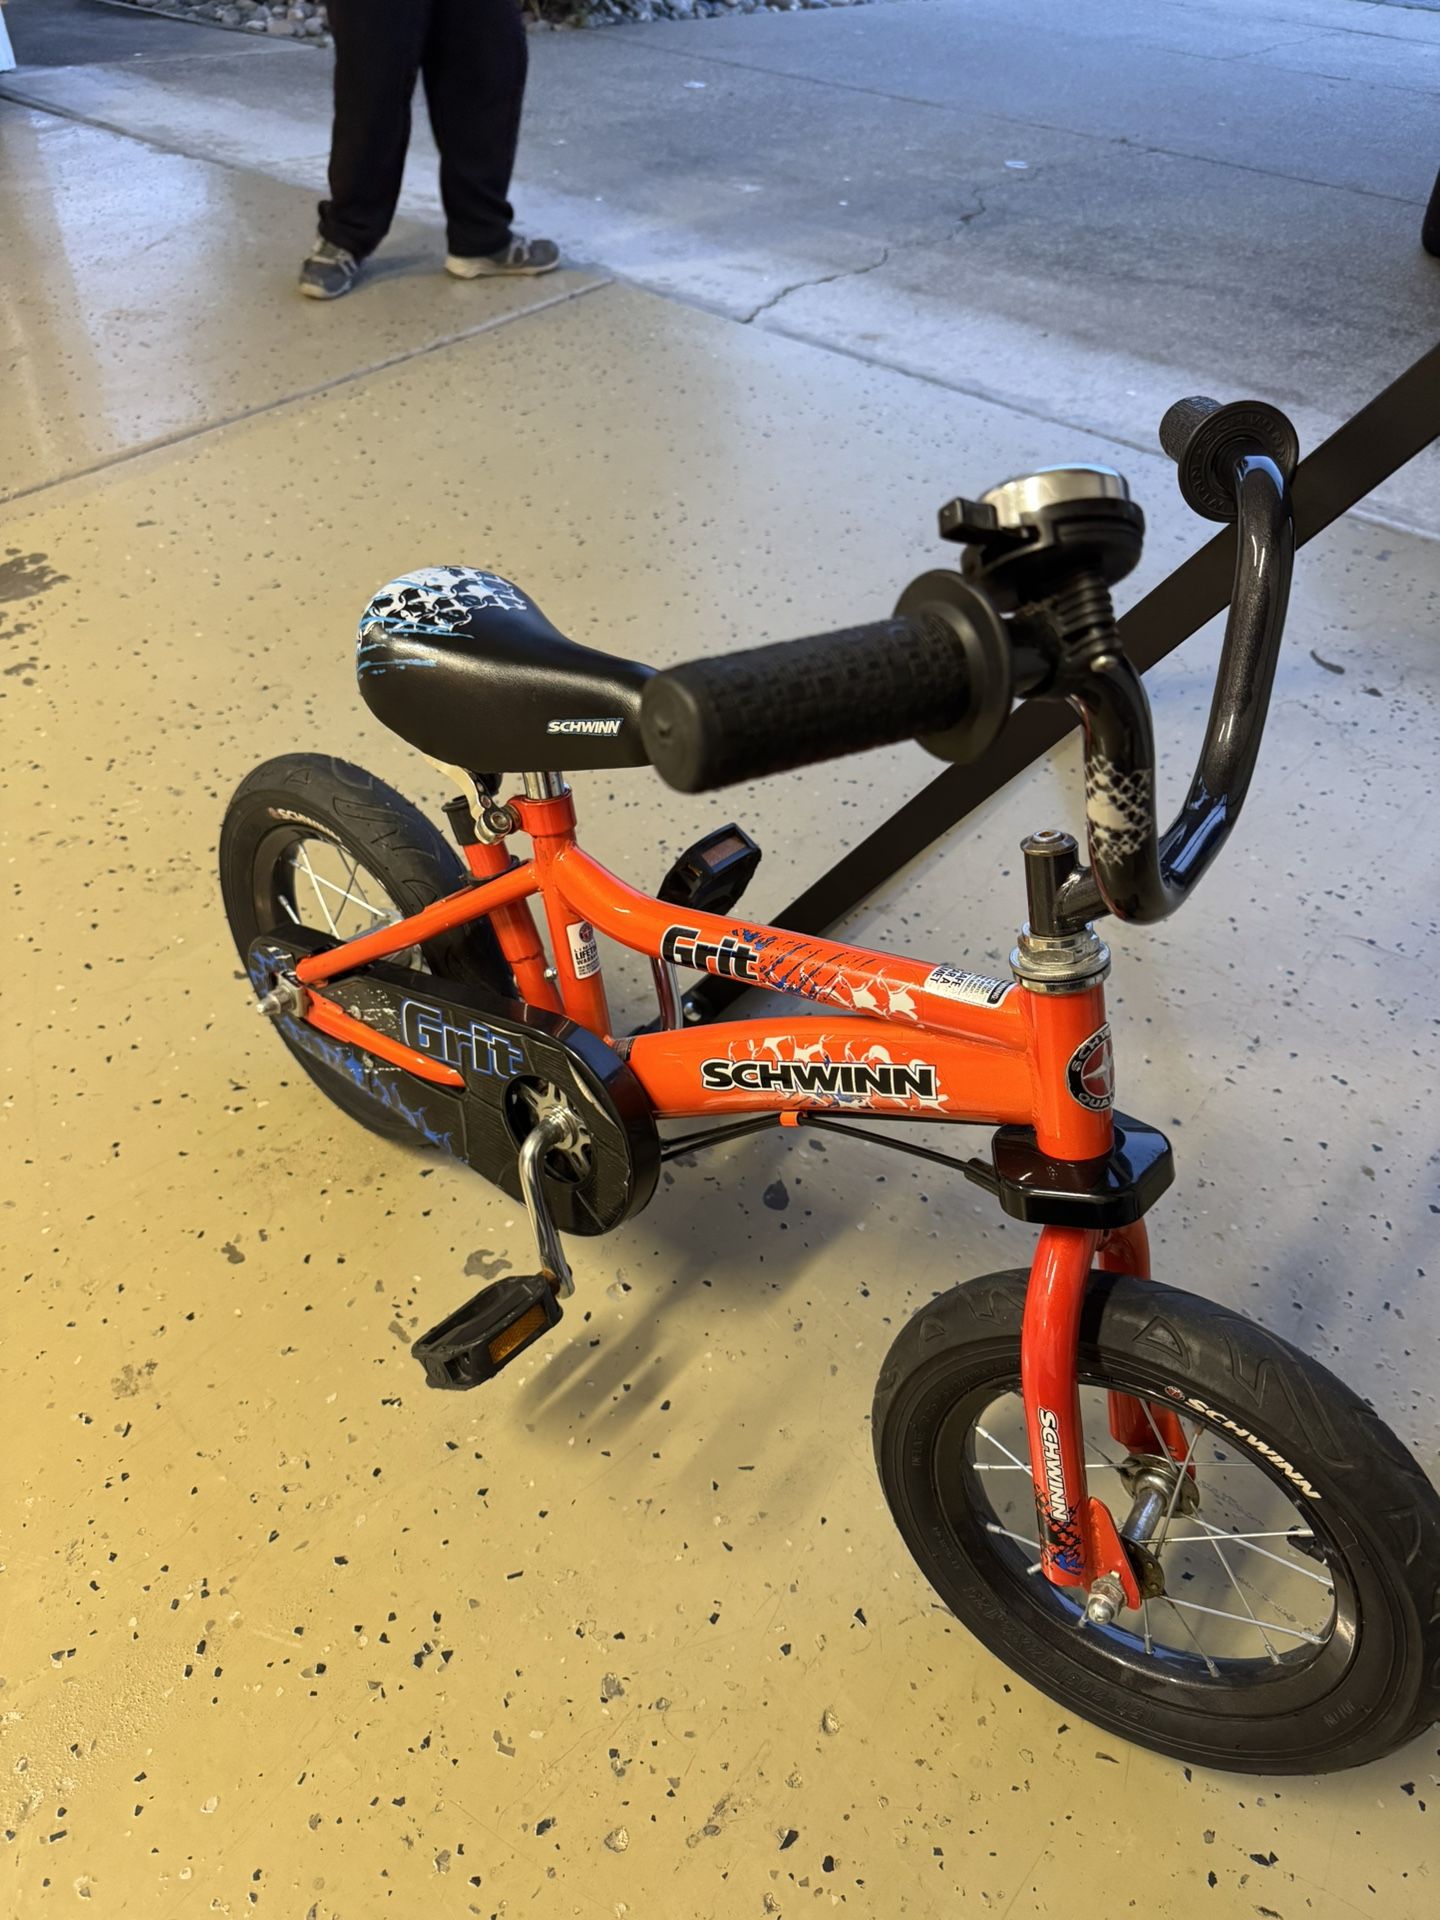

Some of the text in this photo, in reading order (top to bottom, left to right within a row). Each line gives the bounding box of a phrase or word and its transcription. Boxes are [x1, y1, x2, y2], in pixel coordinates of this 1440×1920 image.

[547, 718, 622, 736] SCHWINN
[661, 924, 759, 981] Grit
[401, 997, 524, 1081] Grit
[701, 1057, 938, 1100] SCHWINN
[1038, 1407, 1070, 1522] SCHWINN
[1184, 1397, 1322, 1500] SCHWINN
